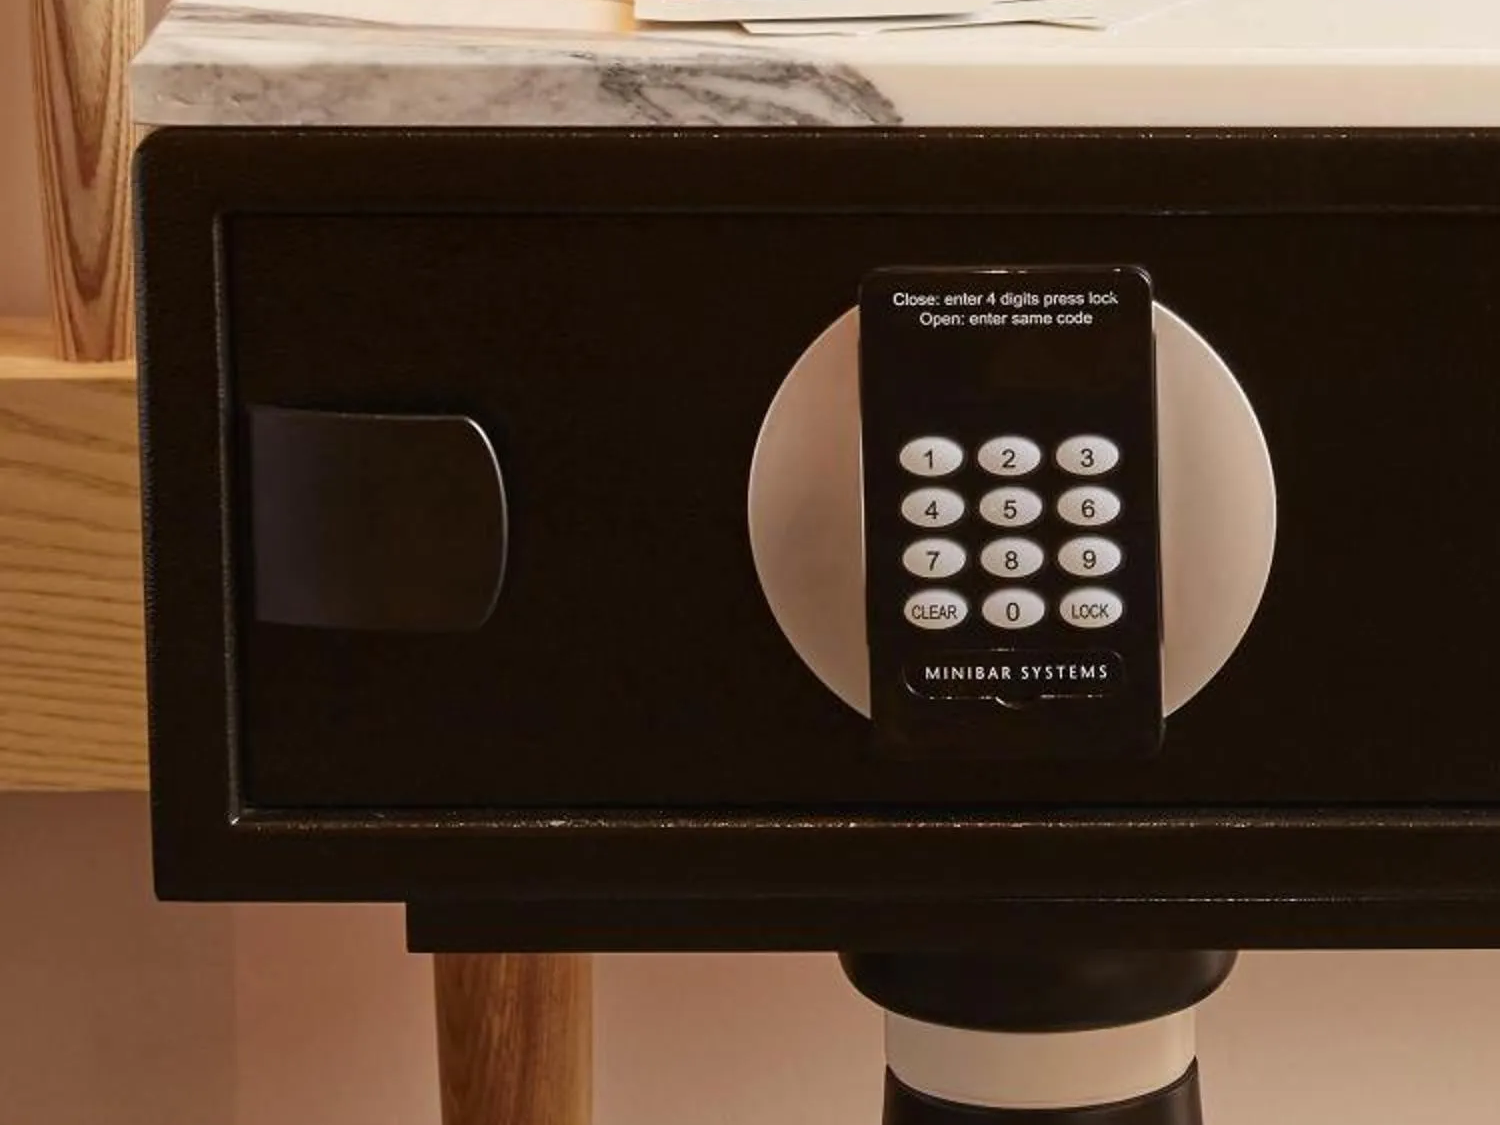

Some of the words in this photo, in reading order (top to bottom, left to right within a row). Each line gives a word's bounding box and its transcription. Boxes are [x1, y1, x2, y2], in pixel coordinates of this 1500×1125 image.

[892, 292, 940, 306] Close:
[943, 292, 983, 306] enter
[986, 292, 997, 306] 4
[999, 291, 1040, 308] digits
[1043, 293, 1085, 308] press
[1088, 290, 1119, 305] lock
[919, 311, 965, 327] Open:
[968, 312, 1009, 326] enter
[1011, 314, 1053, 326] same
[1055, 311, 1093, 325] code
[923, 449, 935, 470] 1
[1001, 448, 1017, 469] 2
[1080, 448, 1096, 468] 3
[924, 500, 940, 520] 4
[1003, 499, 1018, 520] 5
[1081, 498, 1096, 519] 6
[926, 550, 941, 572] 7
[1004, 550, 1019, 571] 8
[1082, 549, 1097, 570] 9
[911, 605, 957, 620] CLEAR
[1005, 601, 1021, 622] 0
[1071, 603, 1109, 620] LOCK
[925, 666, 1011, 680] MINIBAR
[1021, 664, 1107, 680] SYSTEMS
